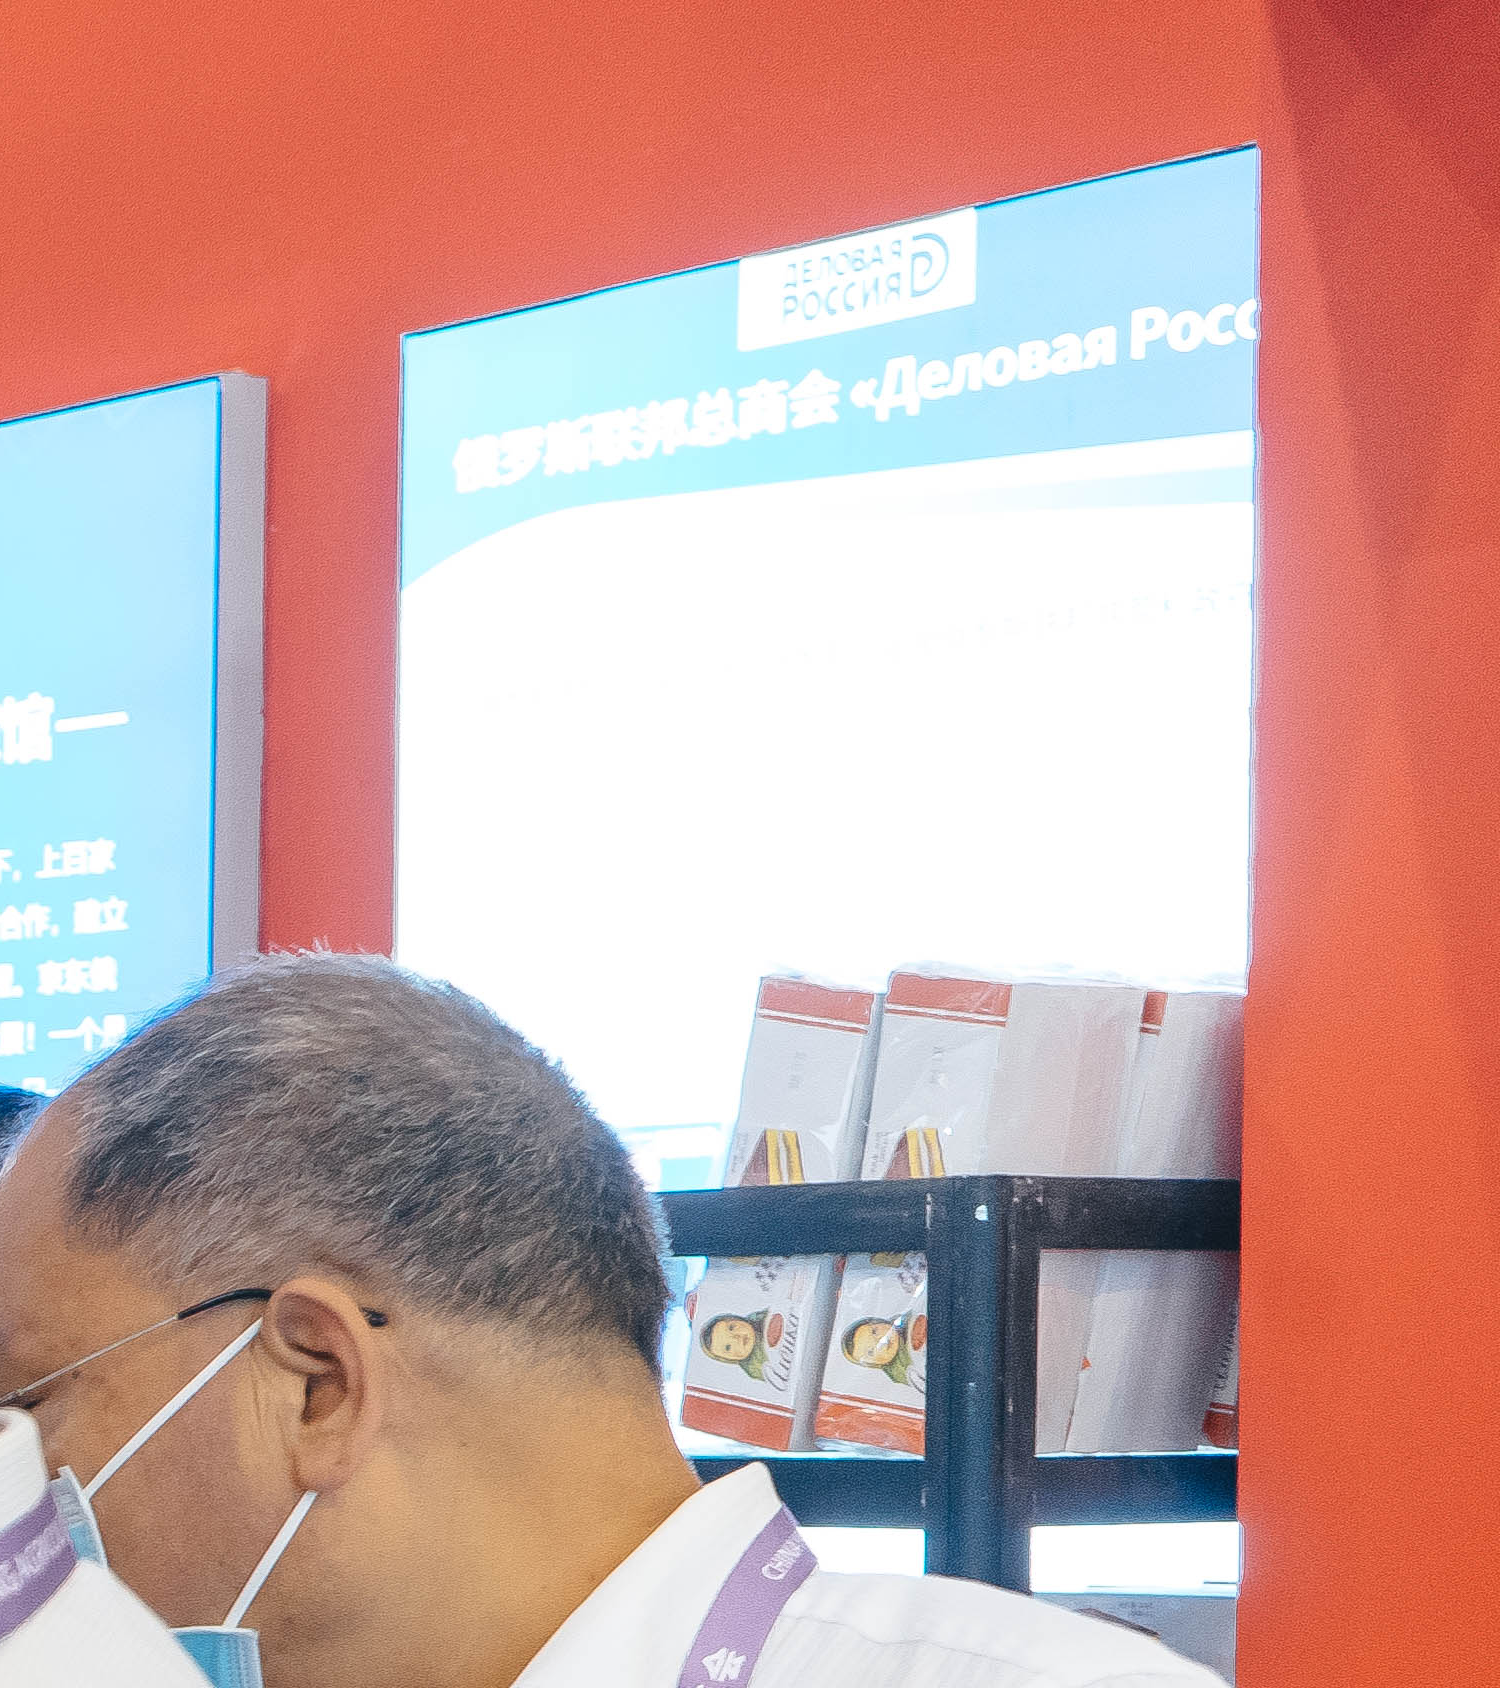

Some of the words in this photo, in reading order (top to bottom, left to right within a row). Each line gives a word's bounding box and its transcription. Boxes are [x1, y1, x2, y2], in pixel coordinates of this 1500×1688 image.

[782, 236, 903, 290] ДЕЛОВАЯ
[782, 268, 903, 323] РОССИЯ
[850, 322, 1116, 422] «Деловая
